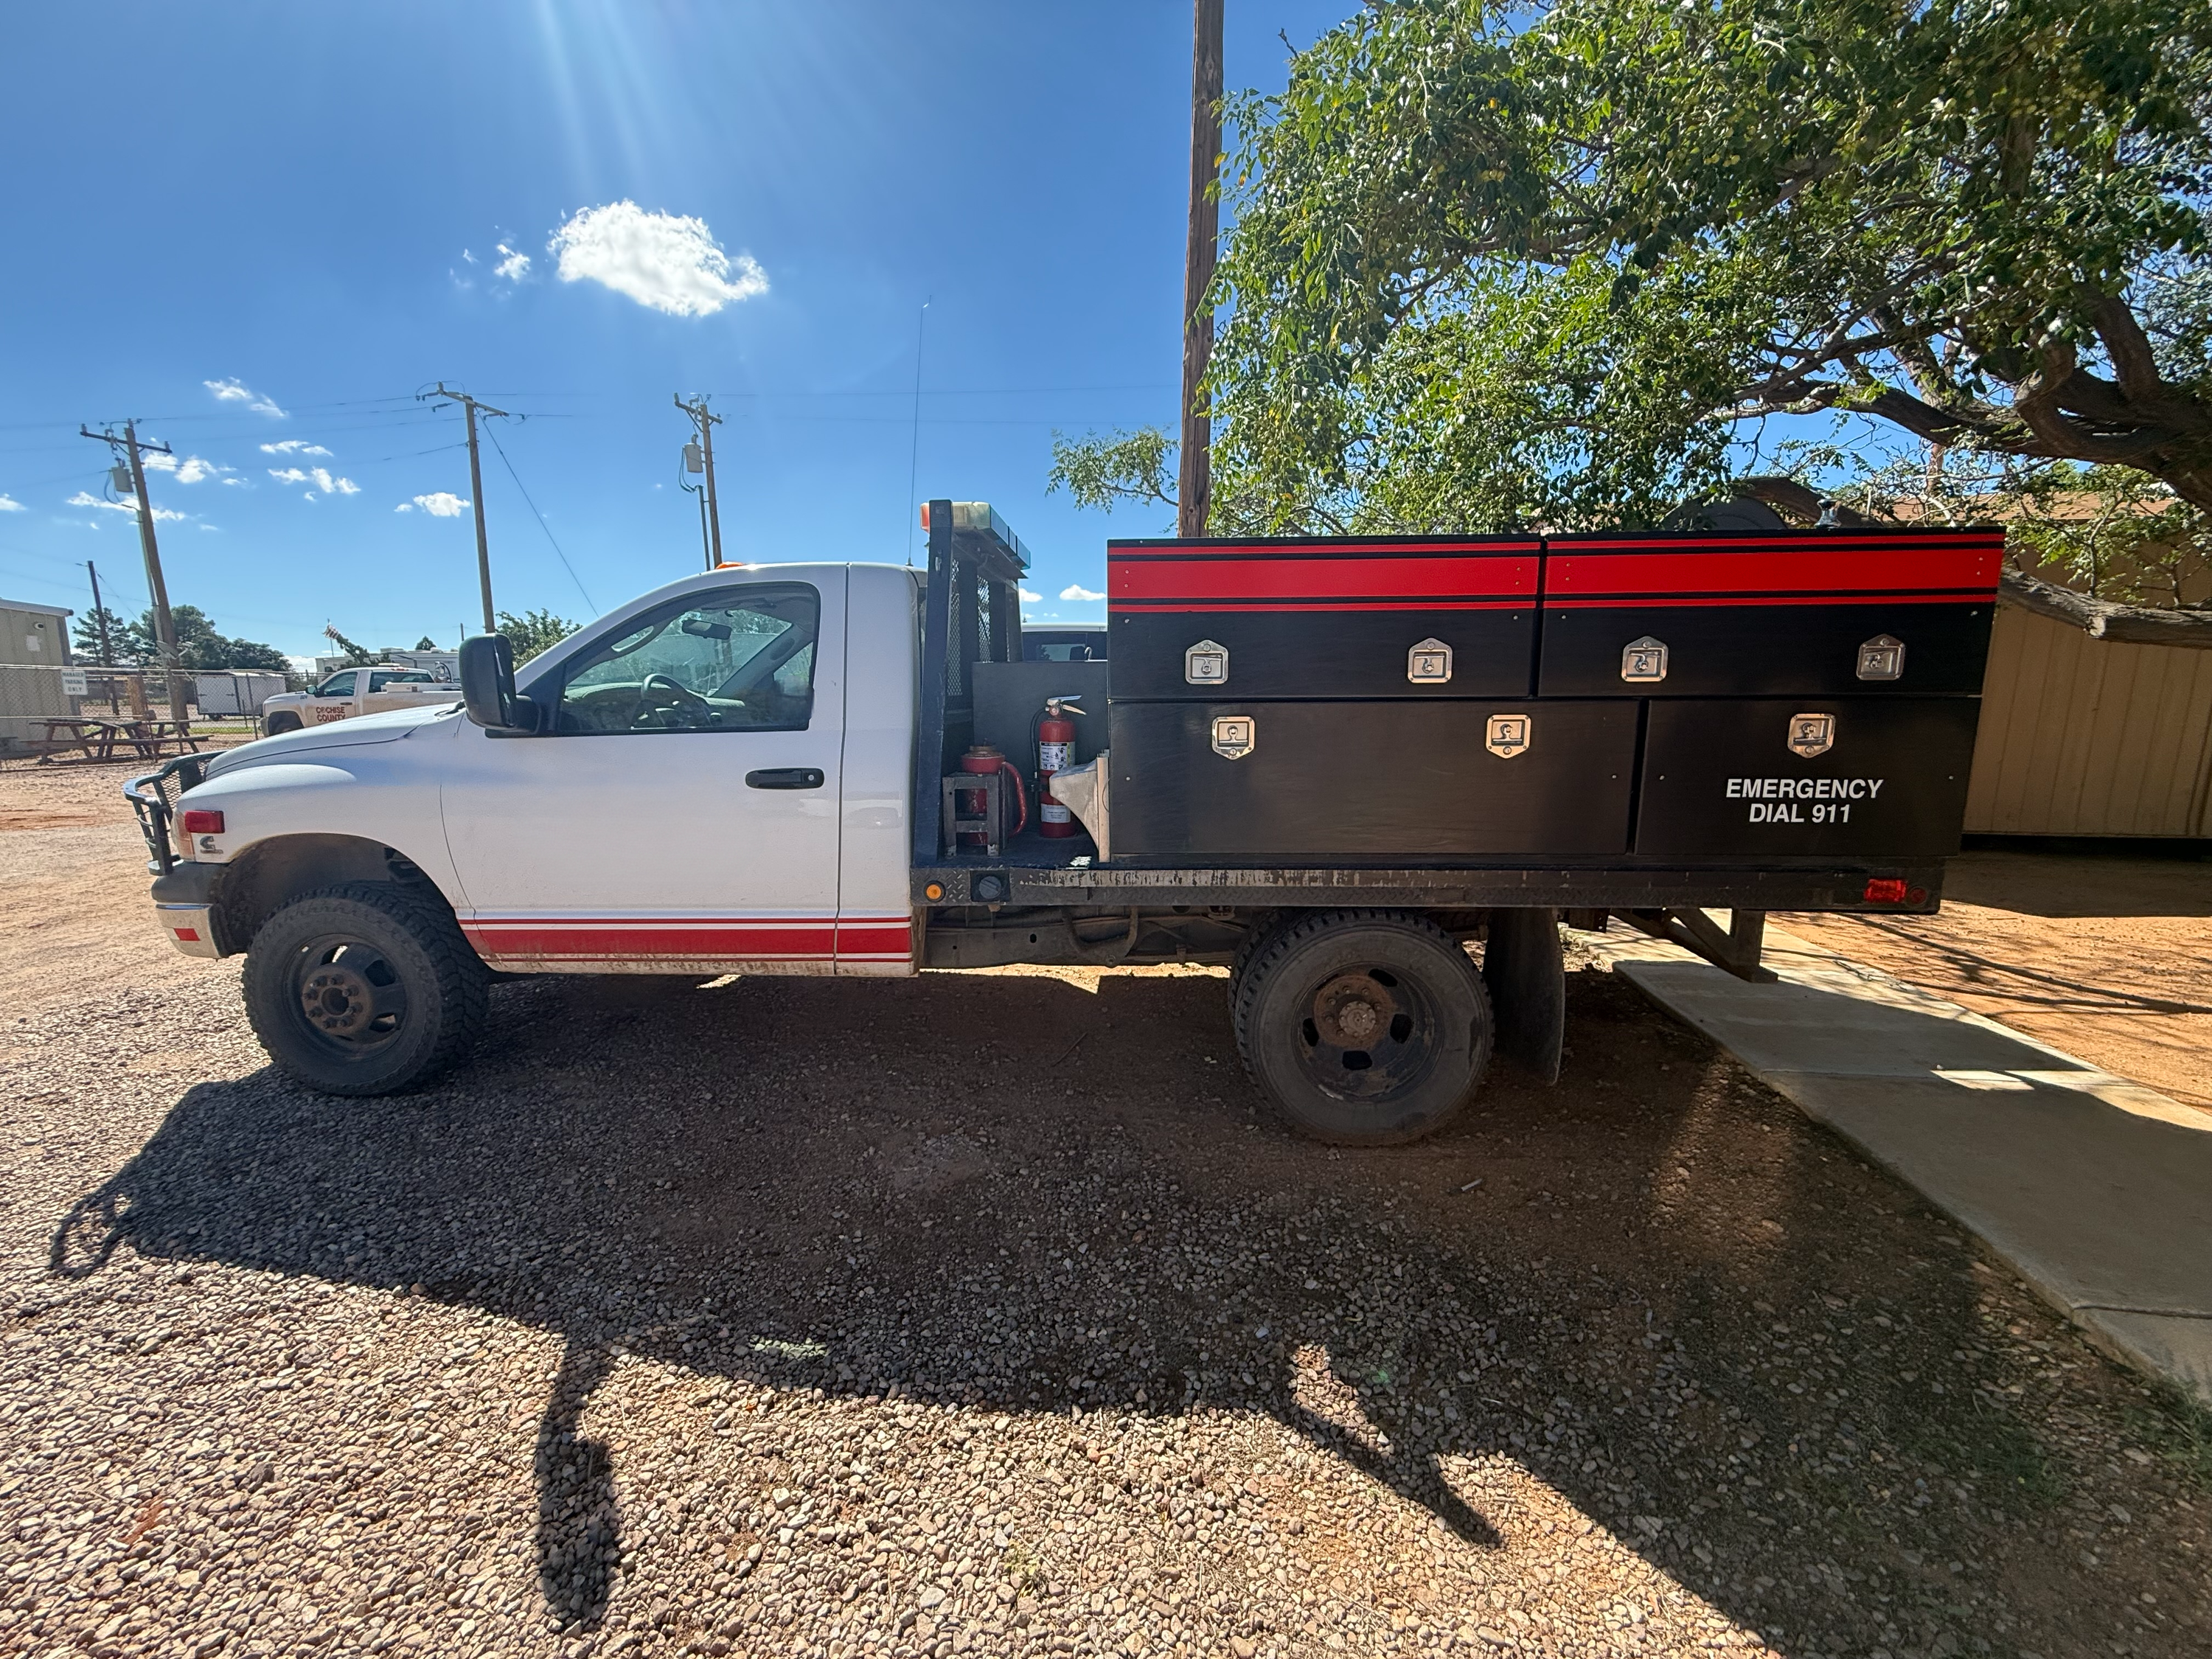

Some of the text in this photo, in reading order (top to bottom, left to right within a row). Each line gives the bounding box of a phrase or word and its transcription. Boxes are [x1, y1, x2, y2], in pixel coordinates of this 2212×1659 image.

[317, 714, 346, 722] COUNTY
[1726, 779, 1884, 799] EMERGENCY
[1749, 803, 1851, 823] DIAL 911
